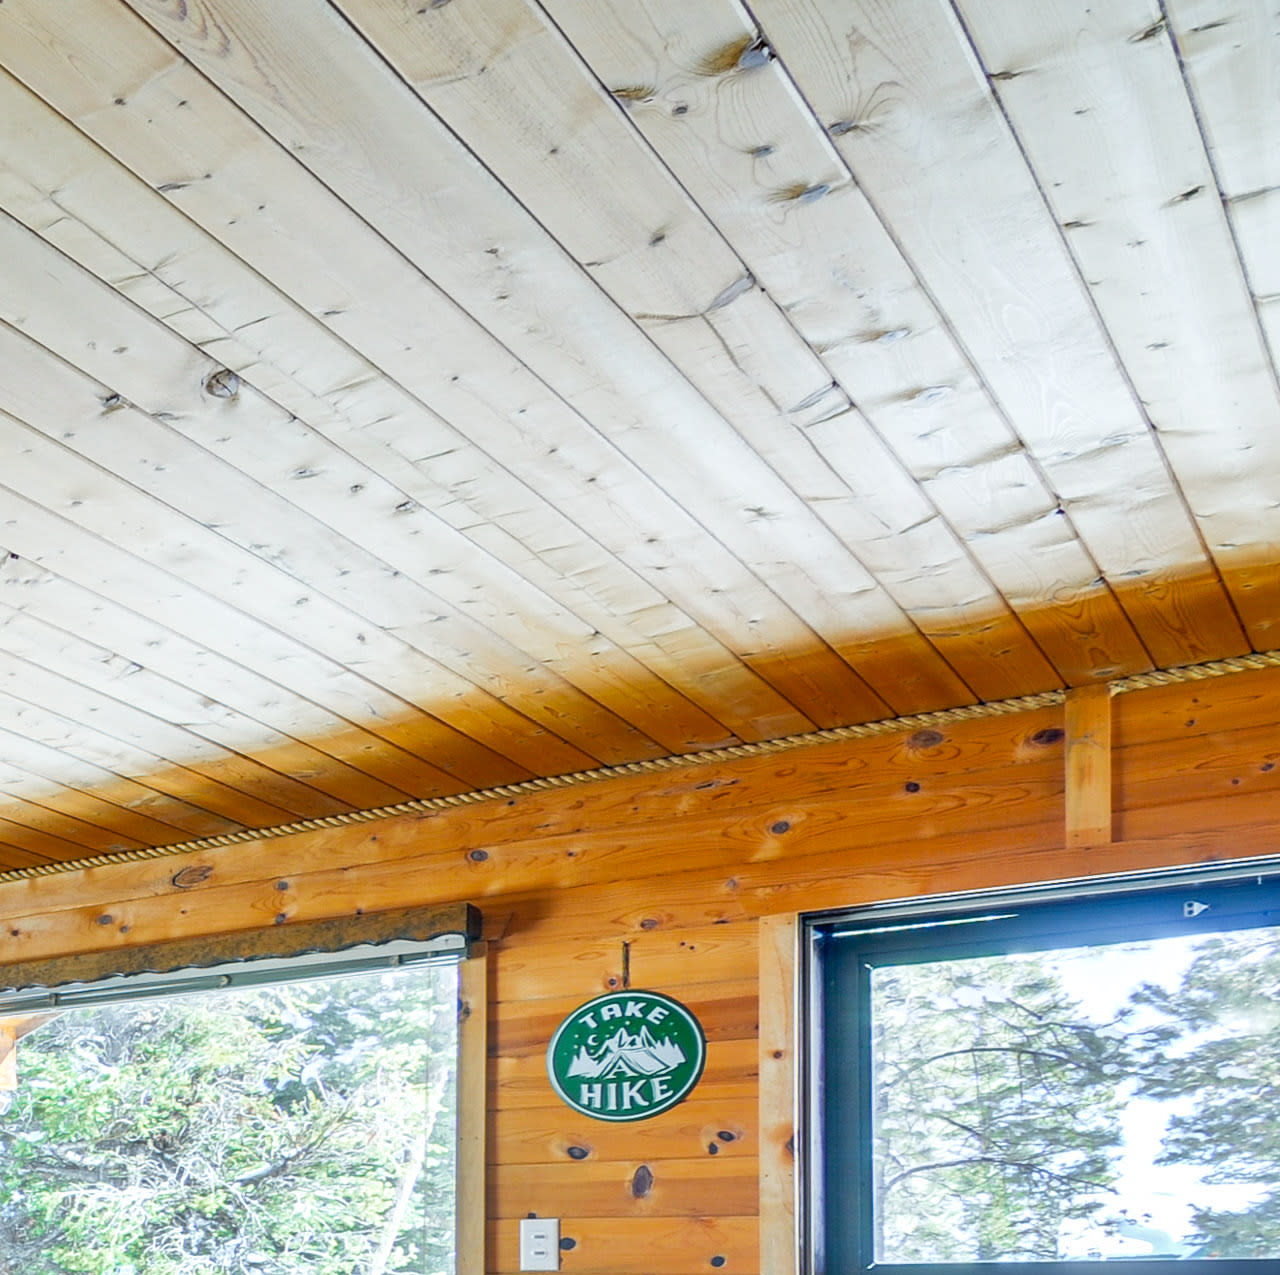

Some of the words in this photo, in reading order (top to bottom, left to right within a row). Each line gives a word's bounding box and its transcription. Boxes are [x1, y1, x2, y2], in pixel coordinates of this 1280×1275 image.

[579, 1001, 671, 1029] TAKE
[605, 1057, 639, 1079] A
[579, 1076, 674, 1111] HIKE
